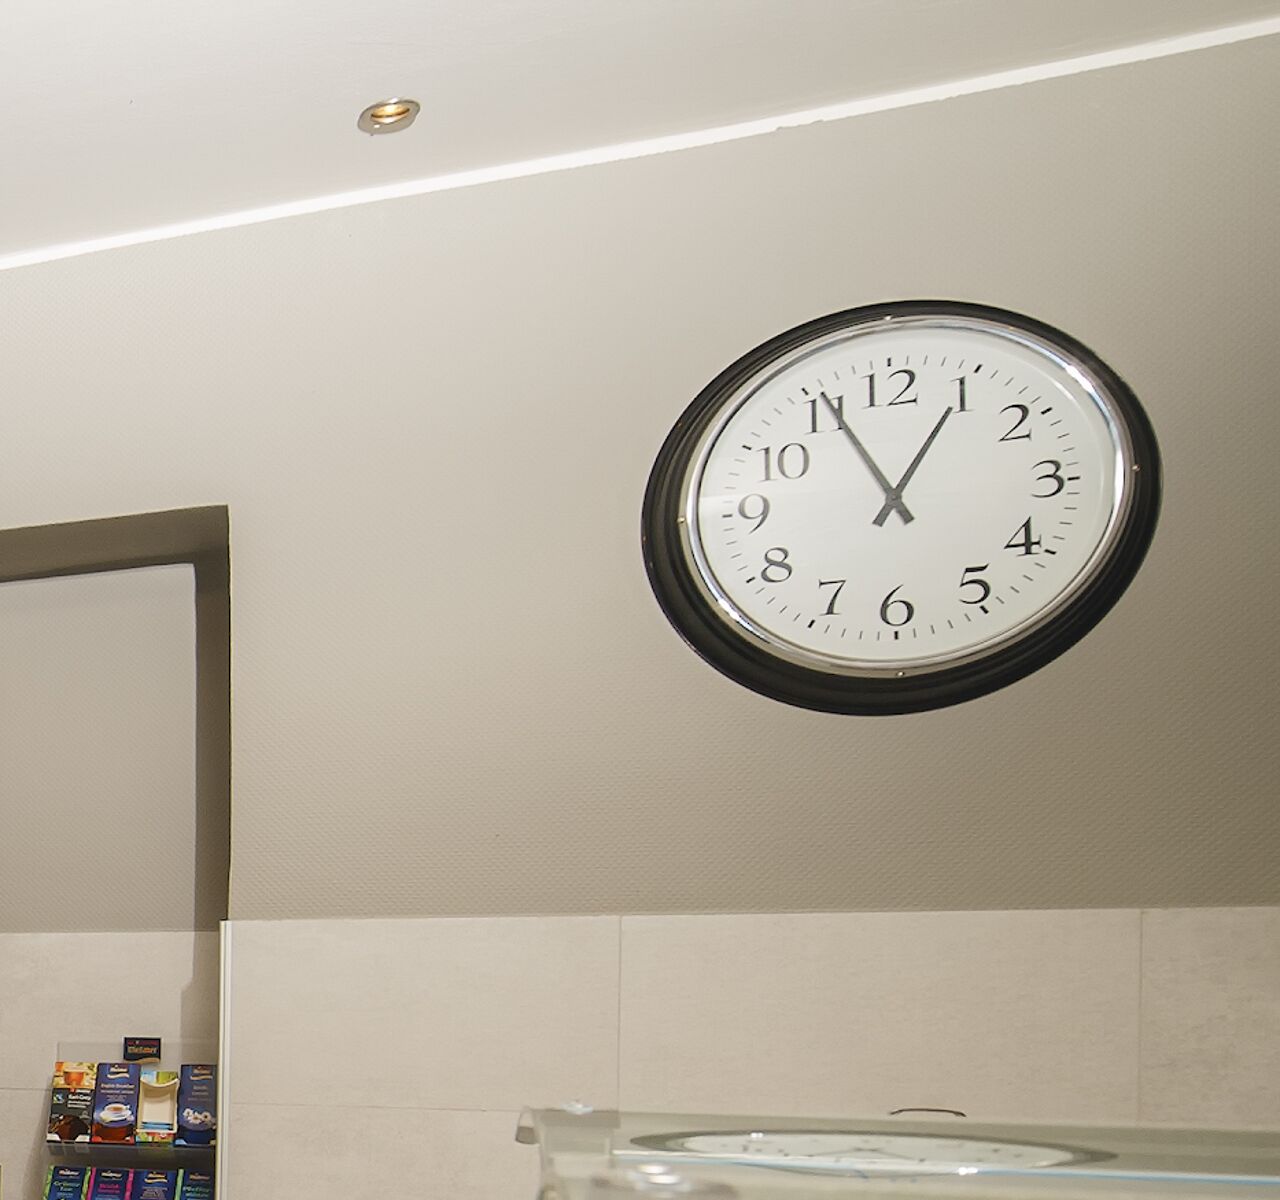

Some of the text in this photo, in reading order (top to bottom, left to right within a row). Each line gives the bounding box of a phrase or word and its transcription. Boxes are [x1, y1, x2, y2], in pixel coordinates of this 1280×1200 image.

[862, 368, 919, 409] 12
[951, 374, 973, 413] 1
[803, 394, 846, 435] 11
[997, 402, 1032, 443] 2
[756, 442, 810, 482] 10
[1031, 459, 1065, 499] 3
[738, 493, 771, 534] 9
[1003, 516, 1042, 557] 4
[761, 546, 793, 583] 8
[959, 563, 992, 605] 5
[817, 579, 847, 617] 7
[880, 584, 915, 627] 6
